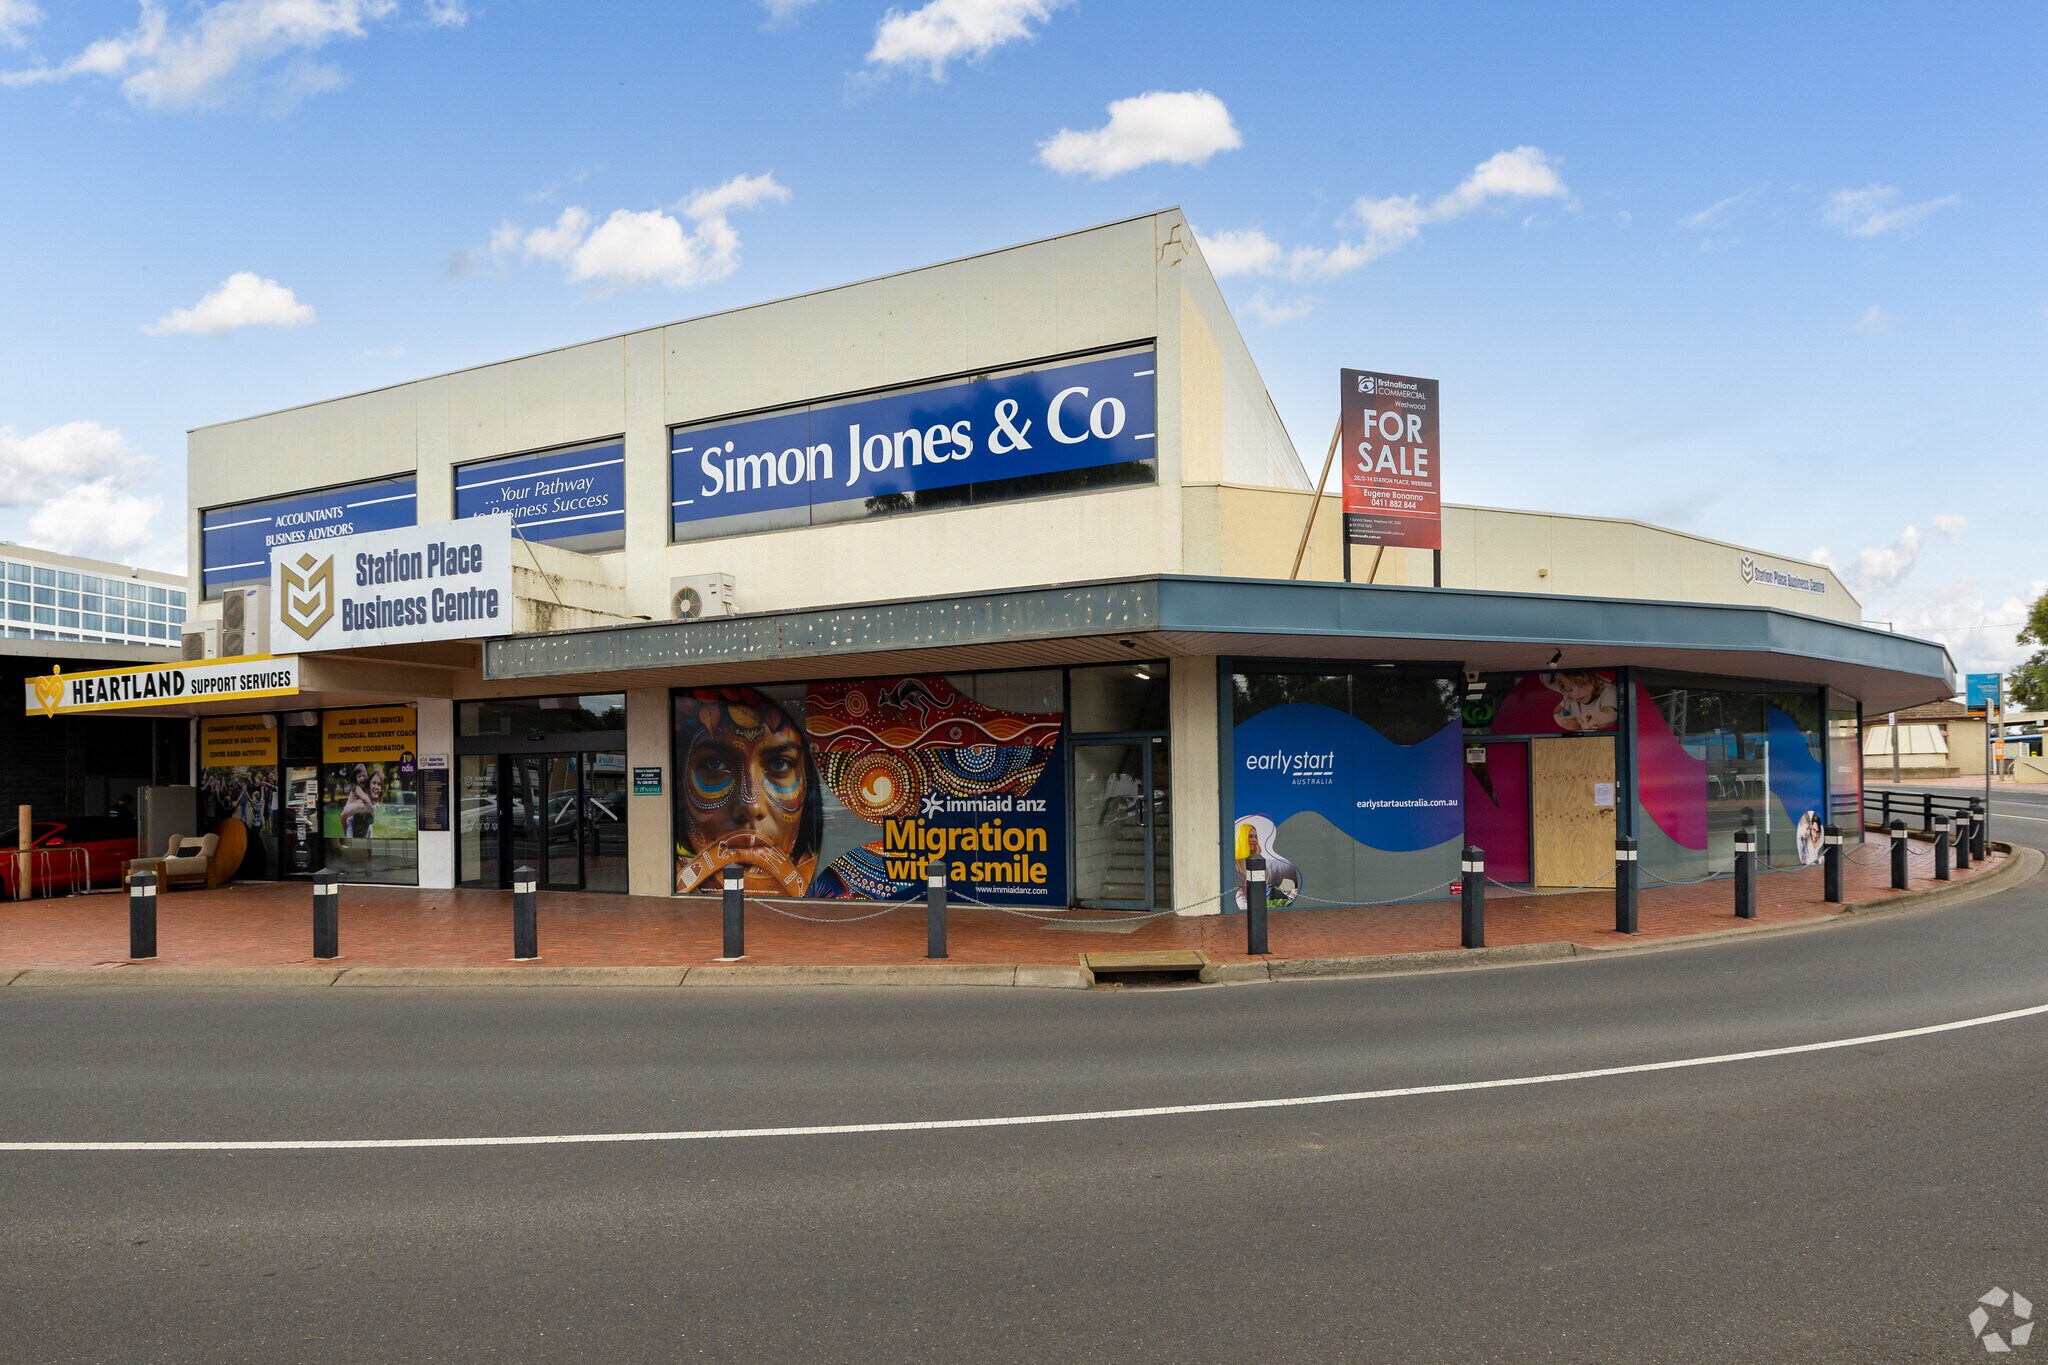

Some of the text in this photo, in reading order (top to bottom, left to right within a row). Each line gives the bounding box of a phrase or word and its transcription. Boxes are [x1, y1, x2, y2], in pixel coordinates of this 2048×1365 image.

[1378, 378, 1418, 390] firstnational
[1378, 388, 1426, 400] COMMERCIAL
[1395, 400, 1426, 410] Westwood
[1364, 408, 1423, 444] FOR
[701, 386, 1126, 497] Simon Jones & Co
[1358, 442, 1428, 478] SALE
[534, 477, 594, 496] Pathway
[1374, 476, 1393, 484] STATION
[552, 493, 608, 512] Success
[1364, 488, 1424, 501] Eugene Bonanno
[1372, 498, 1416, 509] 0411 882 844
[275, 506, 343, 528] ACCOUNTANTS
[266, 522, 354, 546] BUSINESS ADVISORS
[356, 542, 482, 586] Station Place
[342, 586, 498, 632] Business Centre
[72, 670, 291, 704] HEARTLAND SUPPORT SERVICES
[380, 716, 404, 724] SERVICES
[328, 729, 416, 740] PSYCHOSOCIAL RECOVERY COACH
[363, 744, 404, 752] COORDINATION
[402, 764, 414, 772] ndis
[946, 795, 1046, 812] immiaid anz
[1356, 798, 1458, 809] earlystartaustralia.com.au
[886, 818, 1047, 860] Migration
[886, 853, 1048, 884] wit a smile
[975, 885, 1048, 895] www.immiaidanz.com
